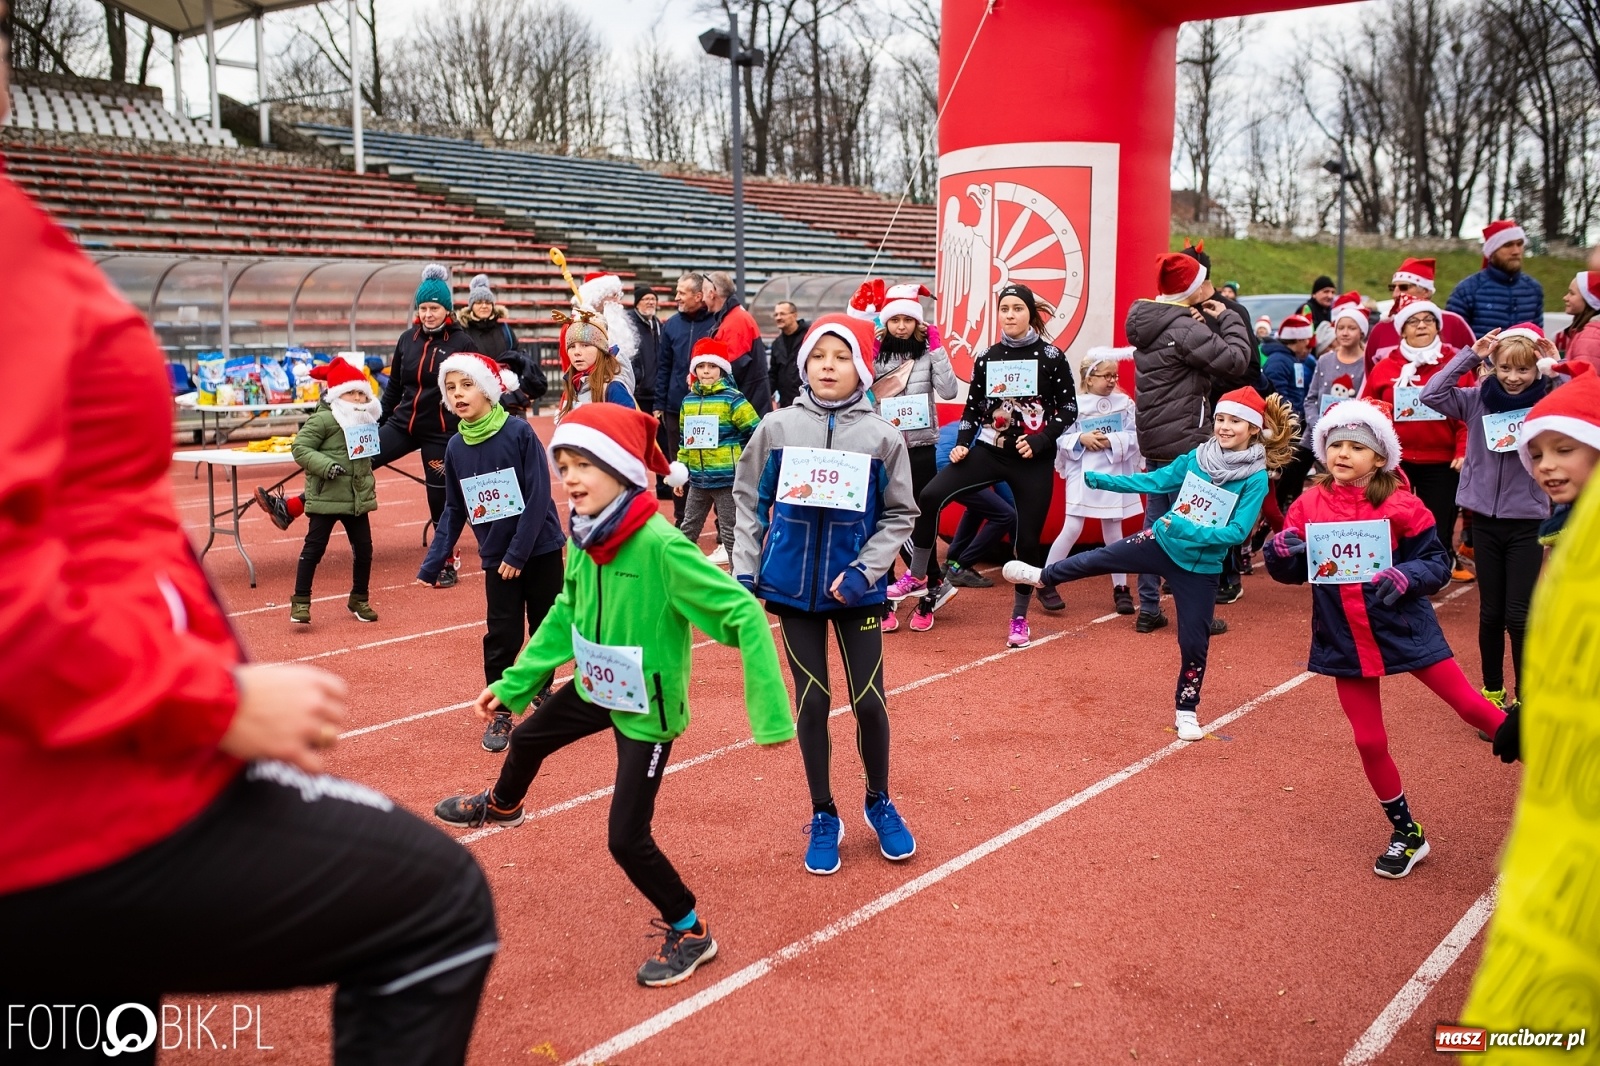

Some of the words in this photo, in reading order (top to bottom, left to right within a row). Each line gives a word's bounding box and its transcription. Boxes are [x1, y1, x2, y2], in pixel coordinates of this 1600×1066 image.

[1004, 373, 1021, 382] 167
[897, 407, 912, 417] 183
[360, 434, 372, 443] 050
[692, 426, 706, 436] 097
[810, 468, 840, 485] 159
[478, 488, 501, 503] 036
[1190, 494, 1213, 512] 207
[1332, 543, 1362, 559] 041
[586, 661, 614, 683] 030
